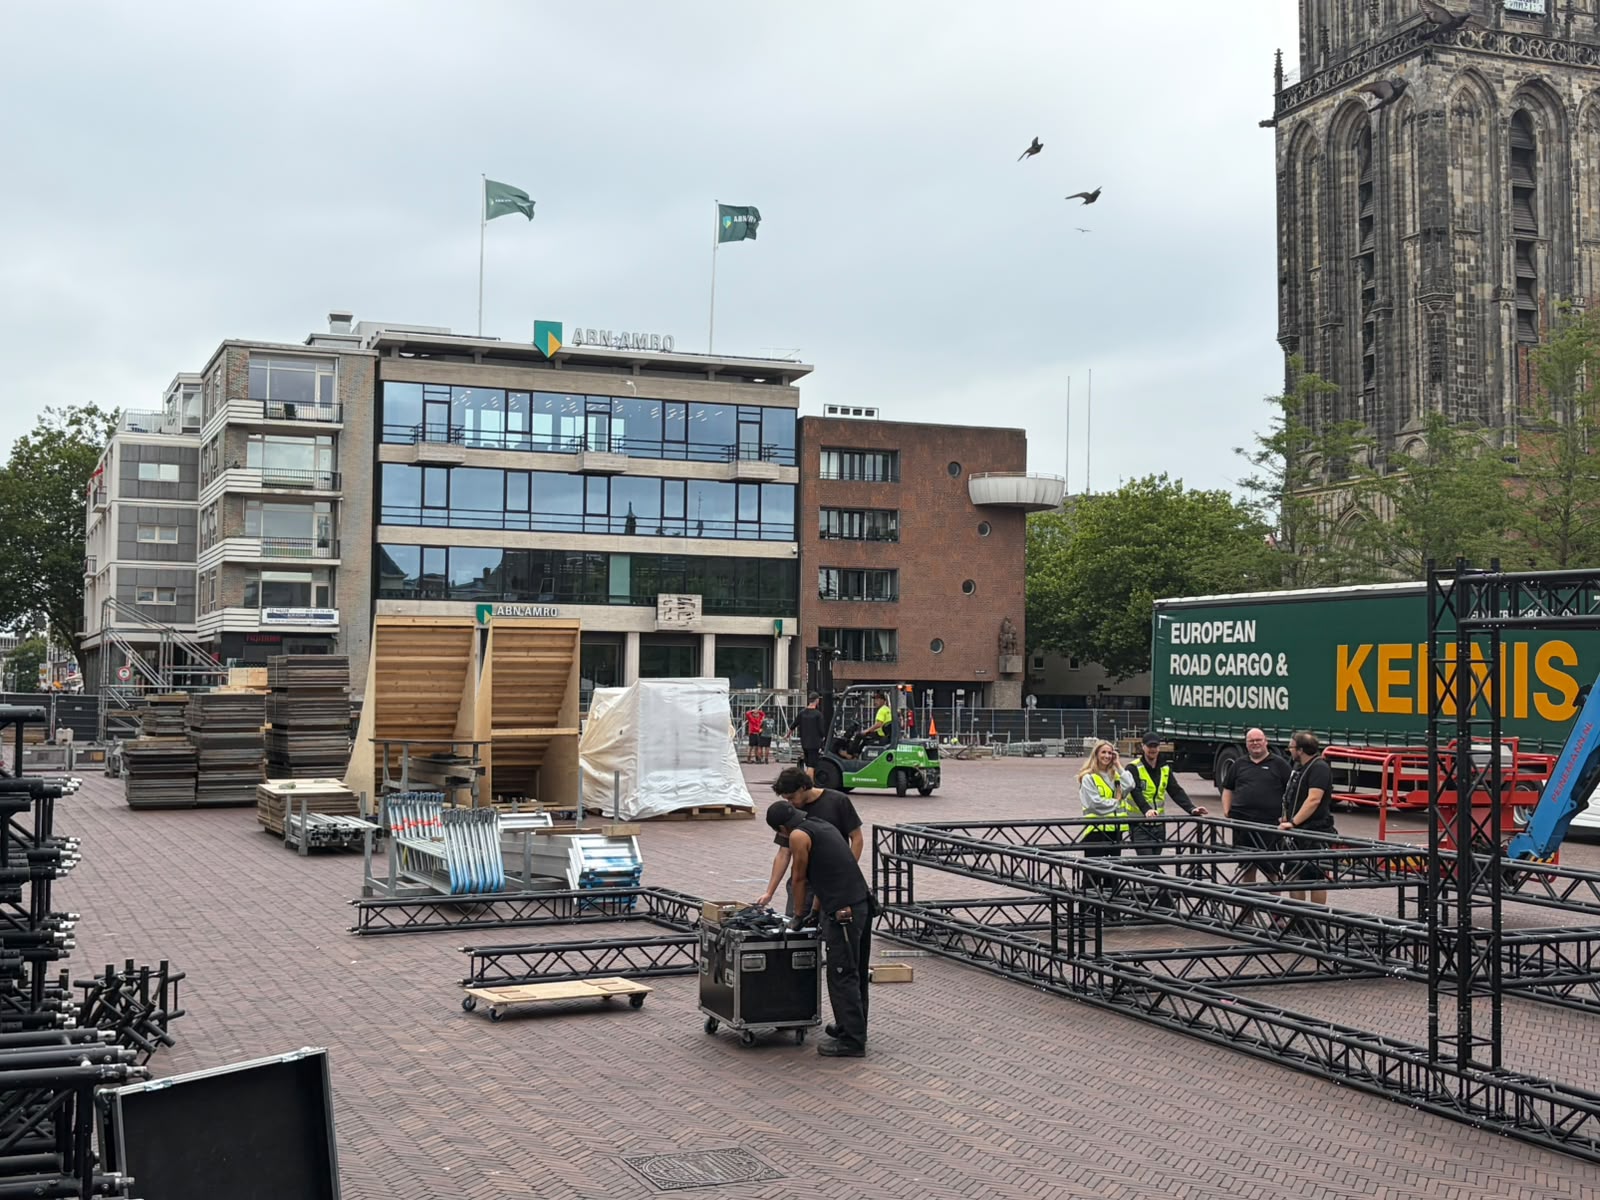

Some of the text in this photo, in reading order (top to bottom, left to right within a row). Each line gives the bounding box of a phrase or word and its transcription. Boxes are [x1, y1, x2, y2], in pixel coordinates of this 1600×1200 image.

[572, 327, 613, 347] ABN
[496, 606, 520, 616] ABN
[1170, 619, 1256, 645] EUROPEAN
[1169, 652, 1289, 677] ROAD CARGO &
[1169, 684, 1289, 711] WAREHOUSING
[1551, 721, 1594, 804] PEINEMANN.NL
